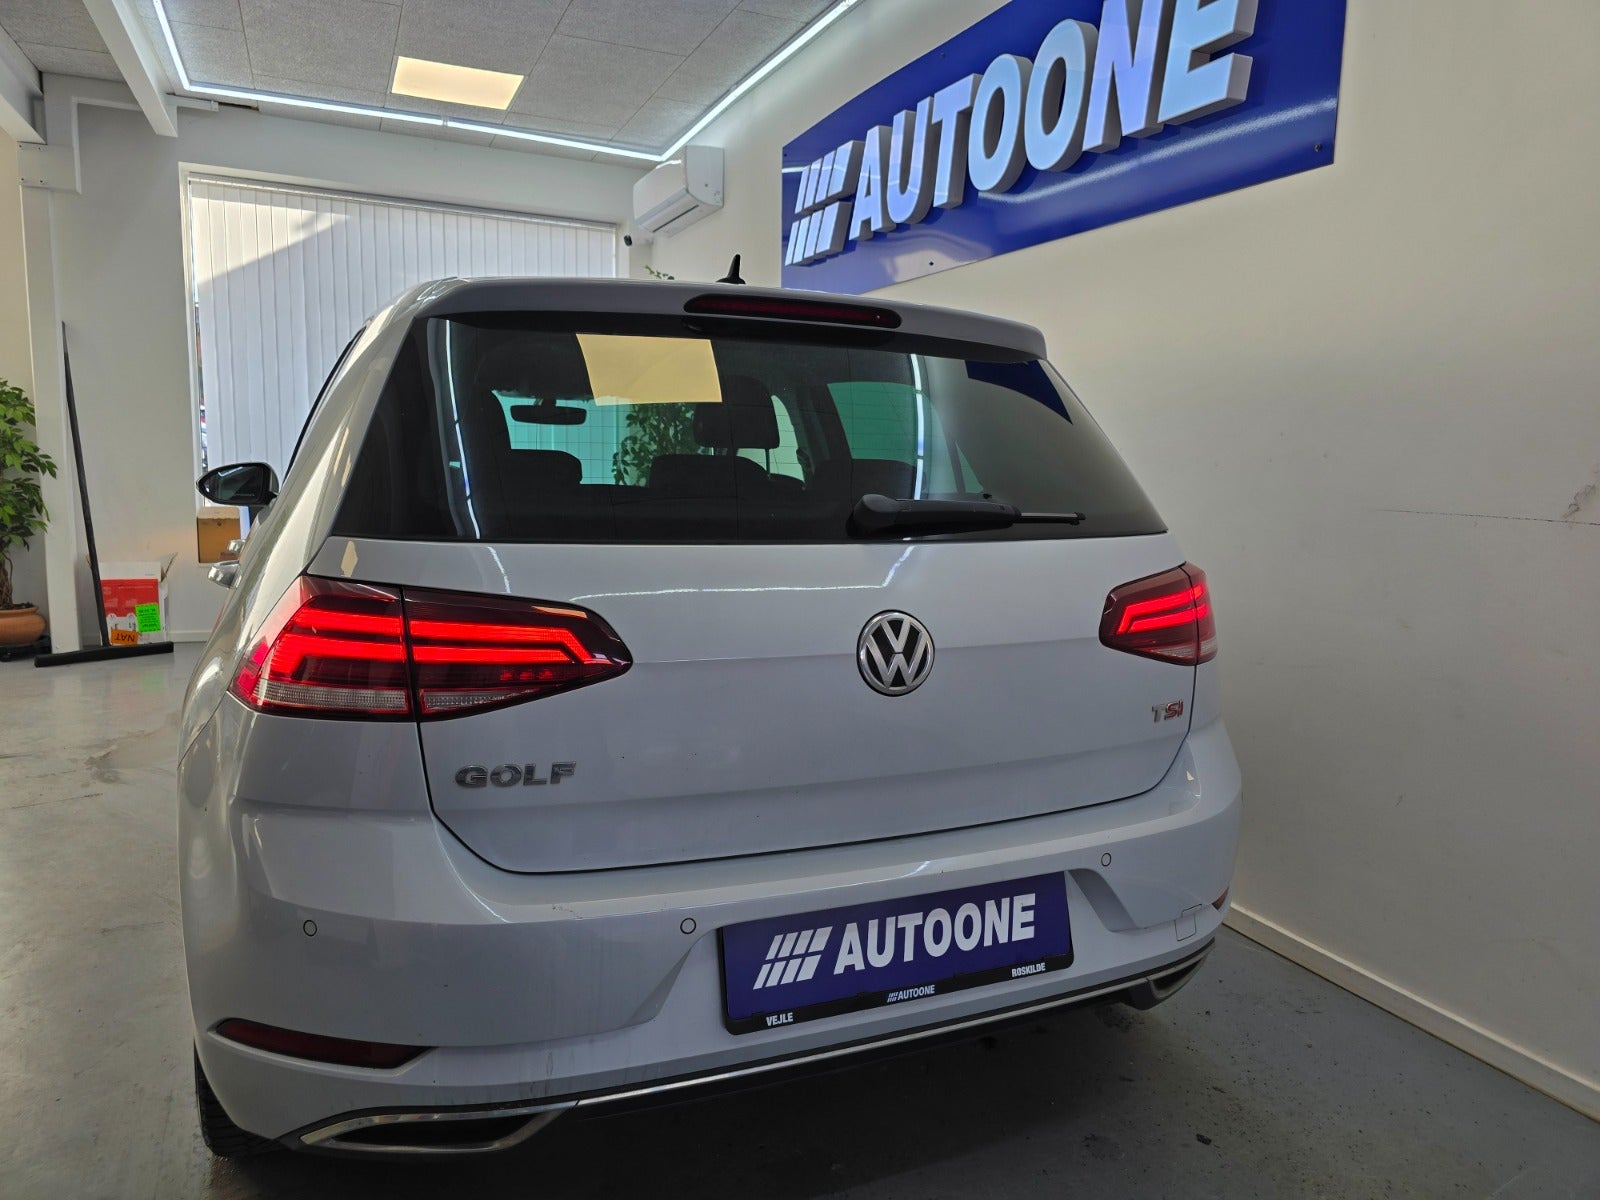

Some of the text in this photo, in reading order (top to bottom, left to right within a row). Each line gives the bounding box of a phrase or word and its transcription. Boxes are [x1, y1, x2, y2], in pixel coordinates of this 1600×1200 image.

[849, 0, 1254, 241] AUTOONE
[1152, 700, 1184, 723] TSI
[455, 761, 576, 788] GOLF
[833, 893, 1036, 975] AUTOONE
[1011, 962, 1046, 977] ROSKILDE
[898, 984, 936, 1001] AUTOONE
[766, 1012, 794, 1026] VEJLE
